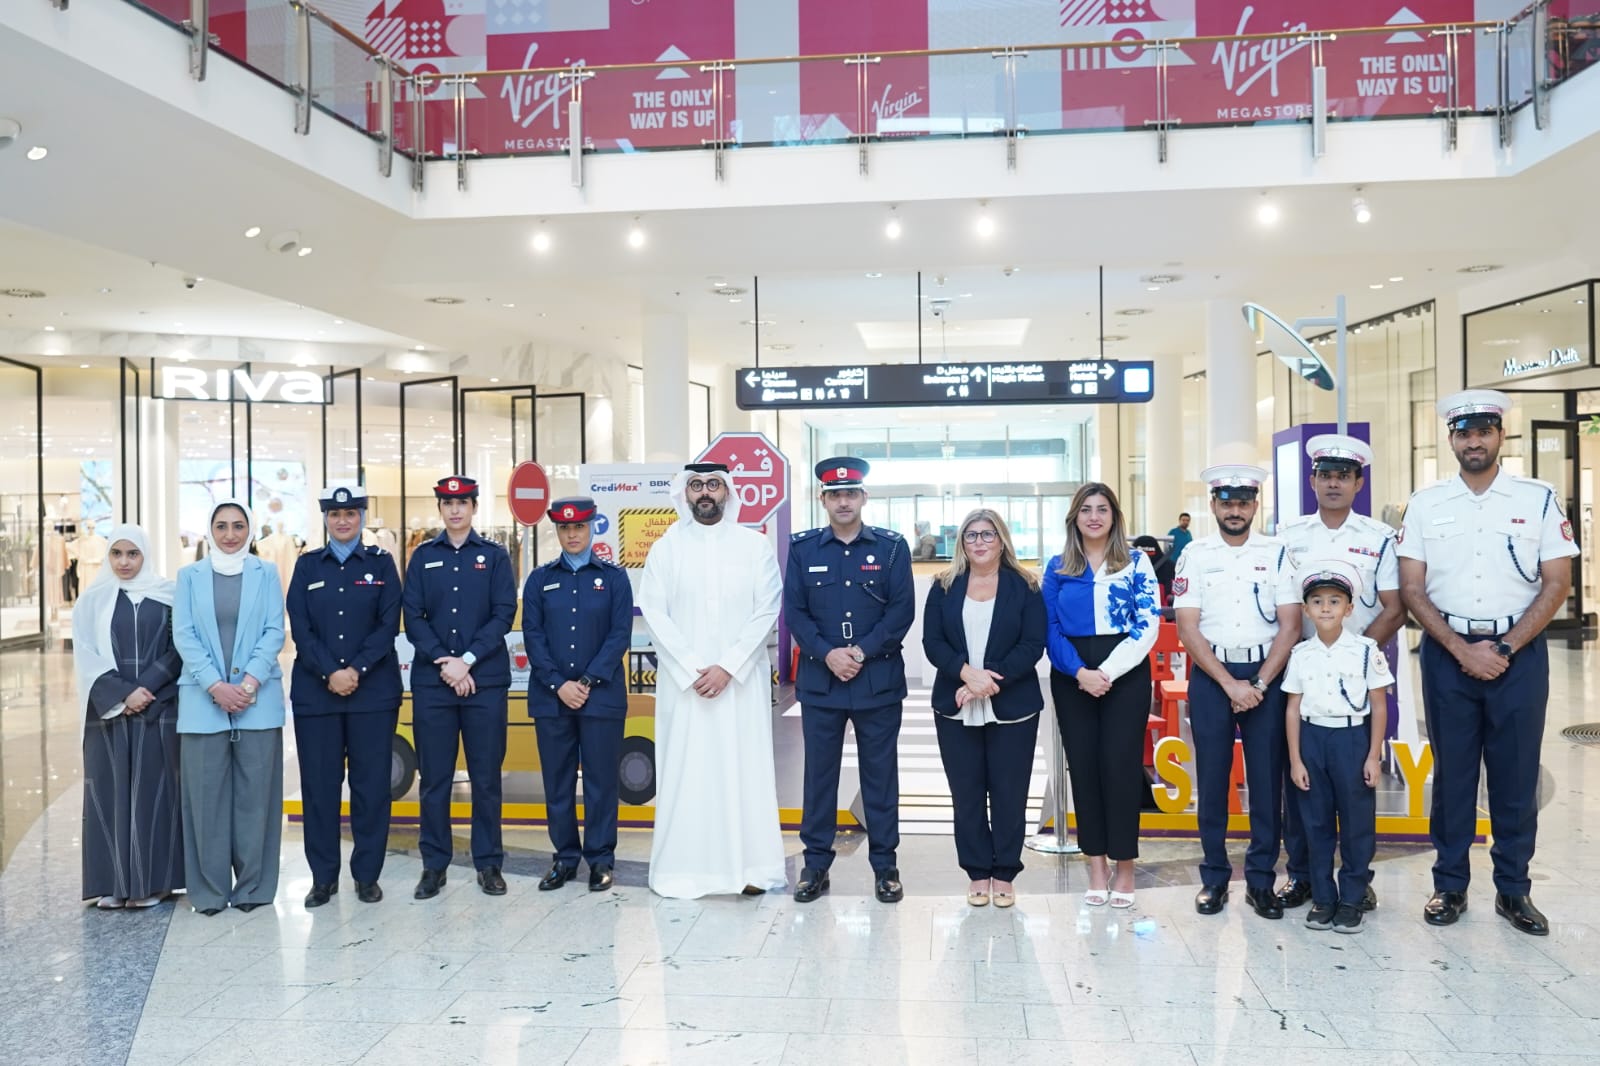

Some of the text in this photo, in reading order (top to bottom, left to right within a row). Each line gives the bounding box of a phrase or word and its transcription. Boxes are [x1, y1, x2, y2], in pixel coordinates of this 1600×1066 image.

[1211, 5, 1310, 97] Virgin
[1360, 54, 1447, 74] THE ONLY
[1356, 76, 1453, 96] WAY IS UP
[632, 88, 713, 109] THE ONLY
[872, 83, 922, 119] Virgin
[629, 109, 716, 129] WAY IS UP
[505, 136, 592, 149] MEGASTOE
[590, 482, 638, 492] CrediMax
[734, 484, 778, 507] OP
